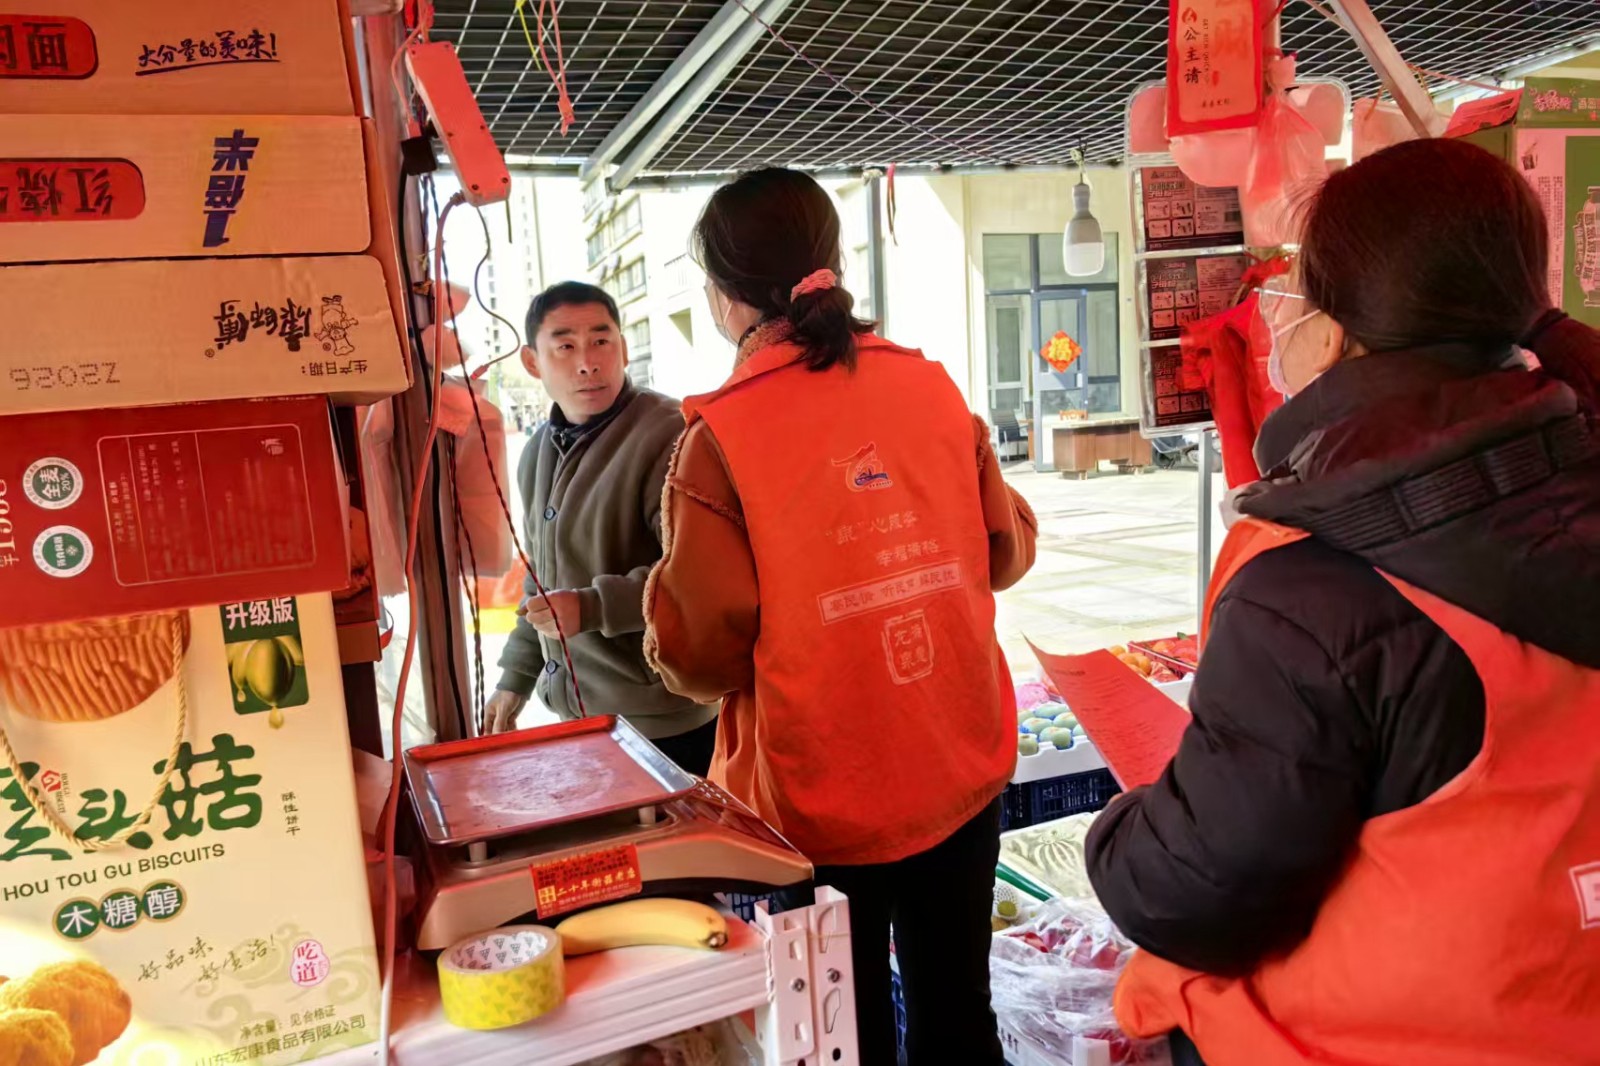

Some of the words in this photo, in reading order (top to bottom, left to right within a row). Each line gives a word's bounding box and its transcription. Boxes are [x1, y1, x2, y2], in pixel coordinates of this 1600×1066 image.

[138, 30, 278, 66] 大分量的美味!
[1184, 26, 1202, 84] 公主请
[0, 168, 113, 216] 红烧
[41, 467, 61, 499] 全麦
[61, 472, 71, 493] 20%
[225, 598, 295, 630] 升级版
[56, 869, 97, 890] TOU
[104, 862, 131, 879] GU
[138, 843, 225, 873] BISCUITS
[61, 885, 181, 935] 木糖醇
[295, 941, 318, 983] 吃道
